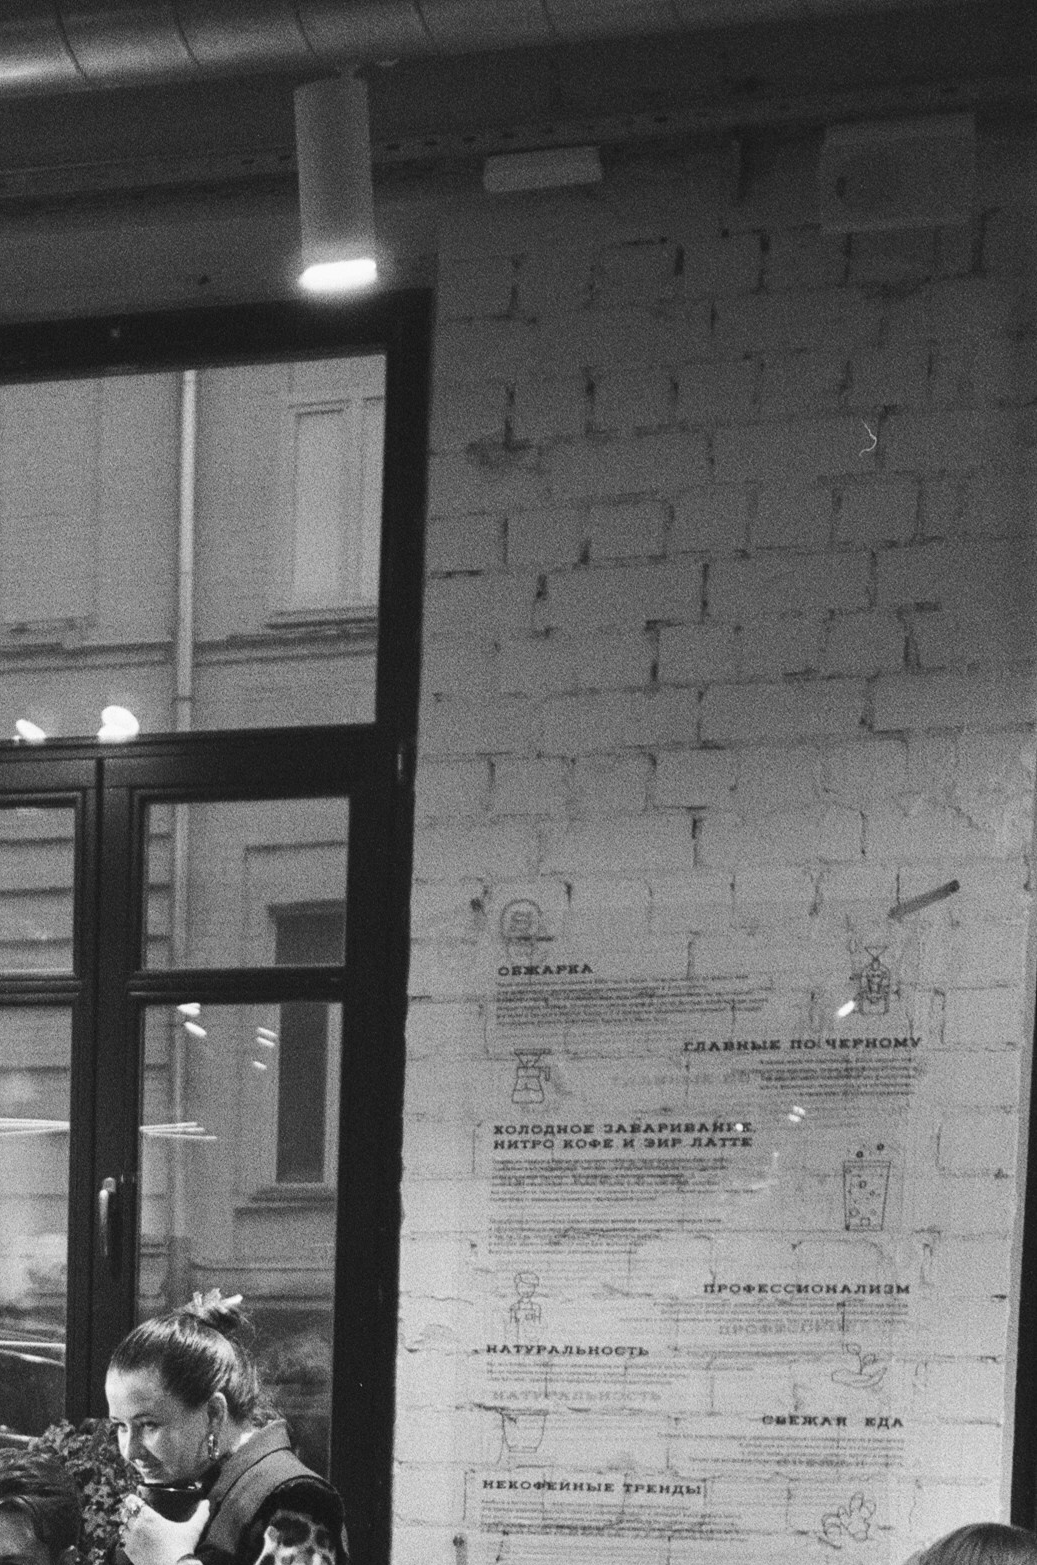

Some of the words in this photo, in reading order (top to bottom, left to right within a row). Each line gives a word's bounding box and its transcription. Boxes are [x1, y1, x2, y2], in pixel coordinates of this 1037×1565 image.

[497, 963, 593, 976] ОБЖАРКА
[683, 1038, 781, 1052] ГЛАВНЫЕ
[790, 1038, 817, 1050] ПО
[825, 1035, 921, 1050] ЧЕРНОМУ
[493, 1123, 594, 1137] ХОЛОДНОЕ
[493, 1138, 555, 1150] НИТРО
[563, 1138, 614, 1150] КОФЕ
[623, 1138, 636, 1149] И
[644, 1137, 682, 1149] ЭИР
[690, 1136, 753, 1148] ЛАТТЕ
[703, 1283, 910, 1295] ПРОФЕССИОНАЛИЗМ
[486, 1344, 650, 1357] НАТУРАЛЬНОСТЬ
[762, 1415, 848, 1427] СВЕЖАЯ
[864, 1417, 904, 1429] ЕДА
[482, 1479, 615, 1493] НЕКОФЕЙНЫЕ
[622, 1482, 702, 1496] ТРЕНДЫ
